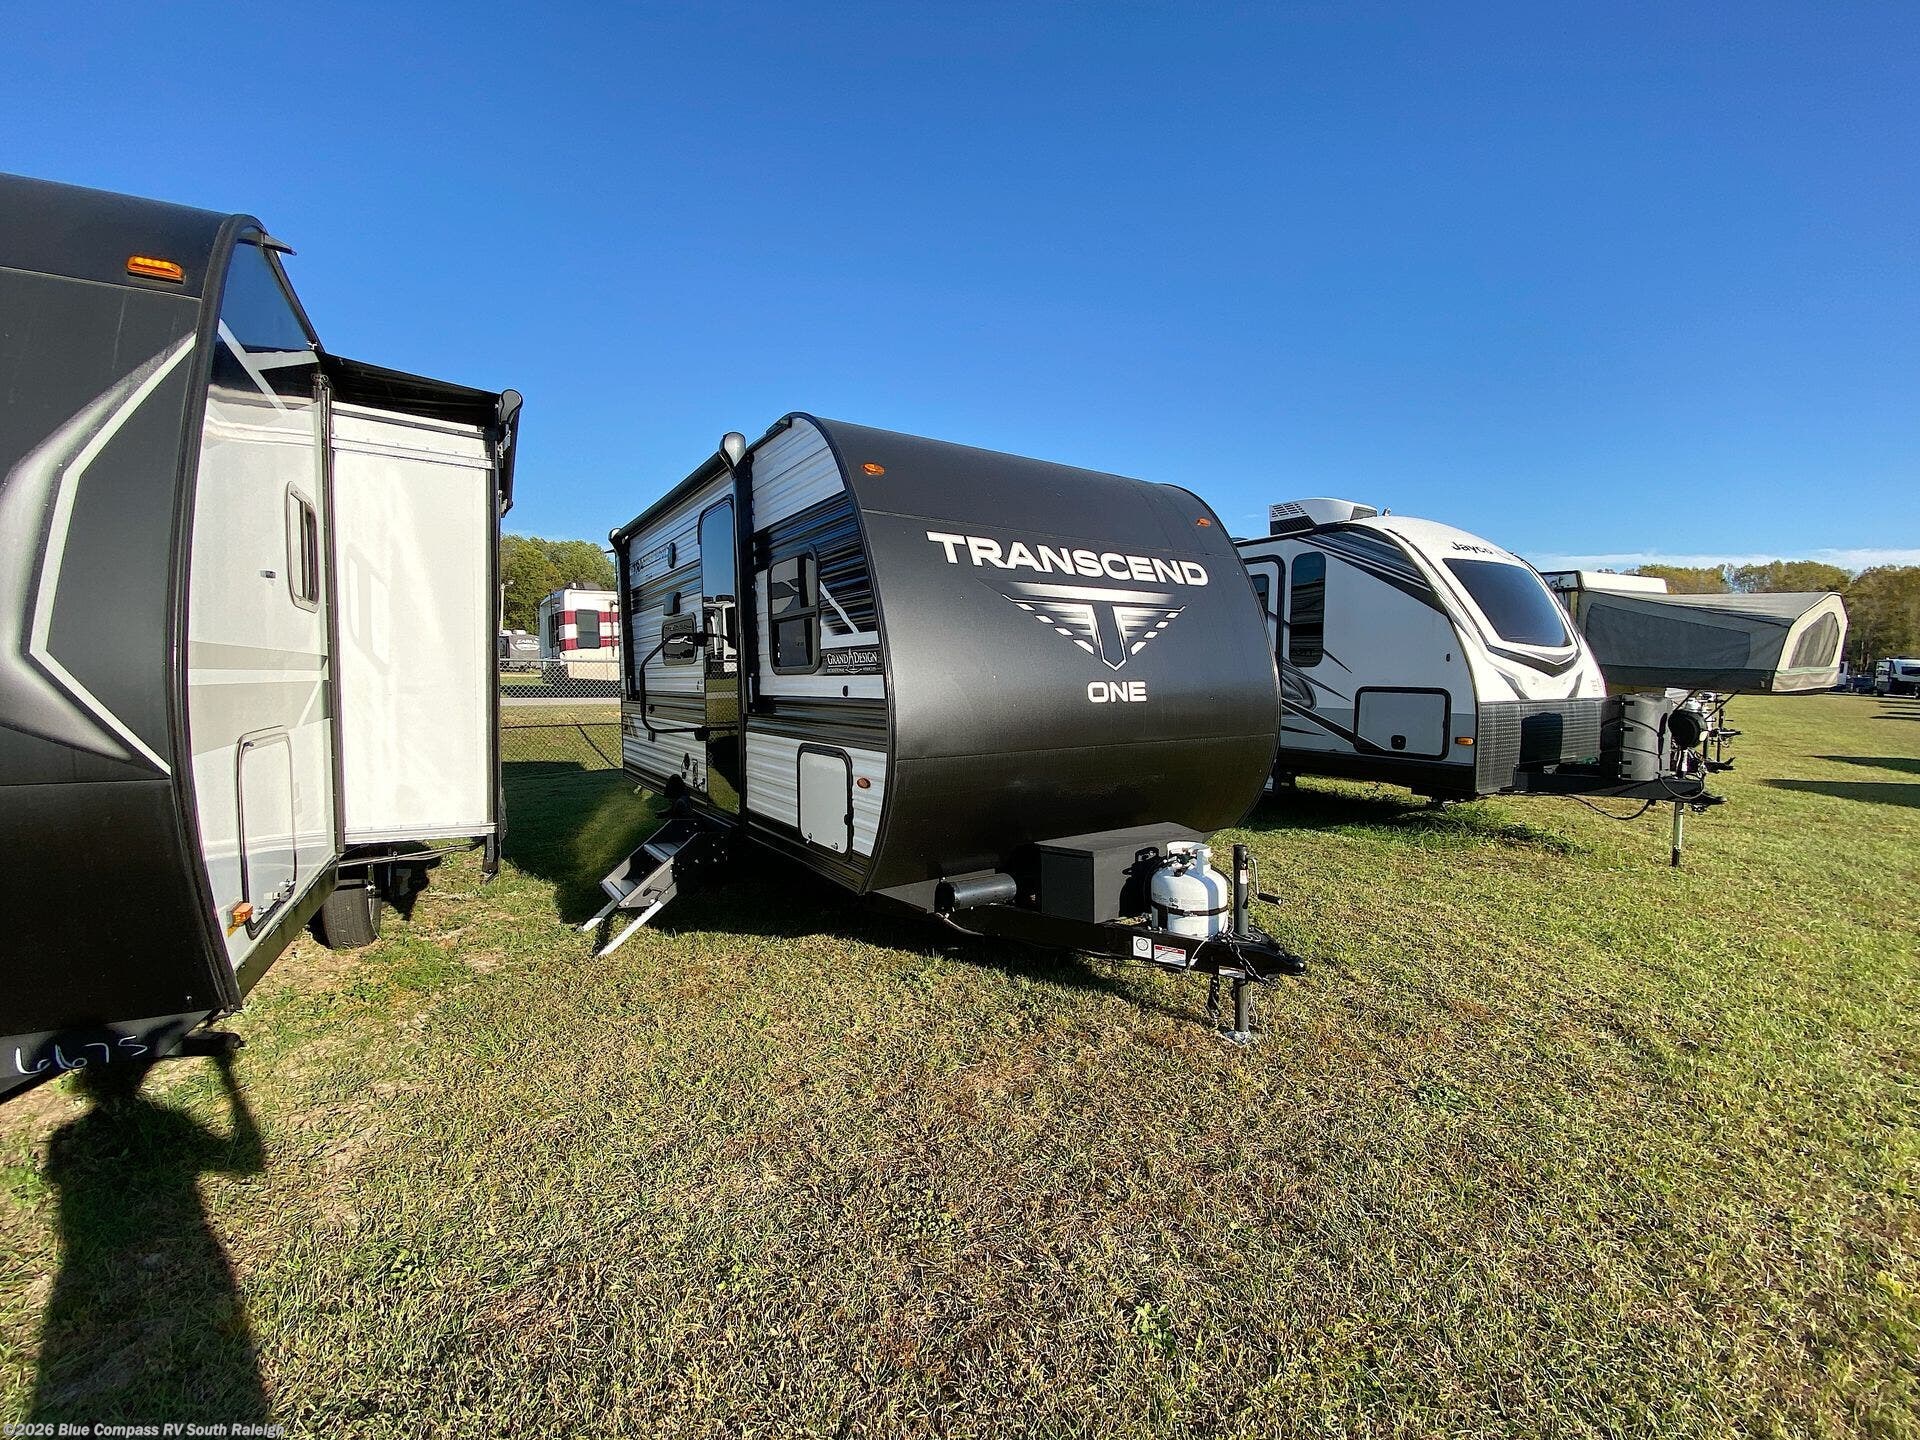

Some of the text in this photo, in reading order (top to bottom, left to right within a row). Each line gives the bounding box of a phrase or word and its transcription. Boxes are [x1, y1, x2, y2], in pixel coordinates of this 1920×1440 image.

[925, 531, 1209, 586] TRANSCEND
[1450, 541, 1494, 555] Jayco
[826, 651, 878, 665] GRAND DESIGN
[1087, 681, 1147, 703] ONE
[15, 1035, 148, 1075] 6675
